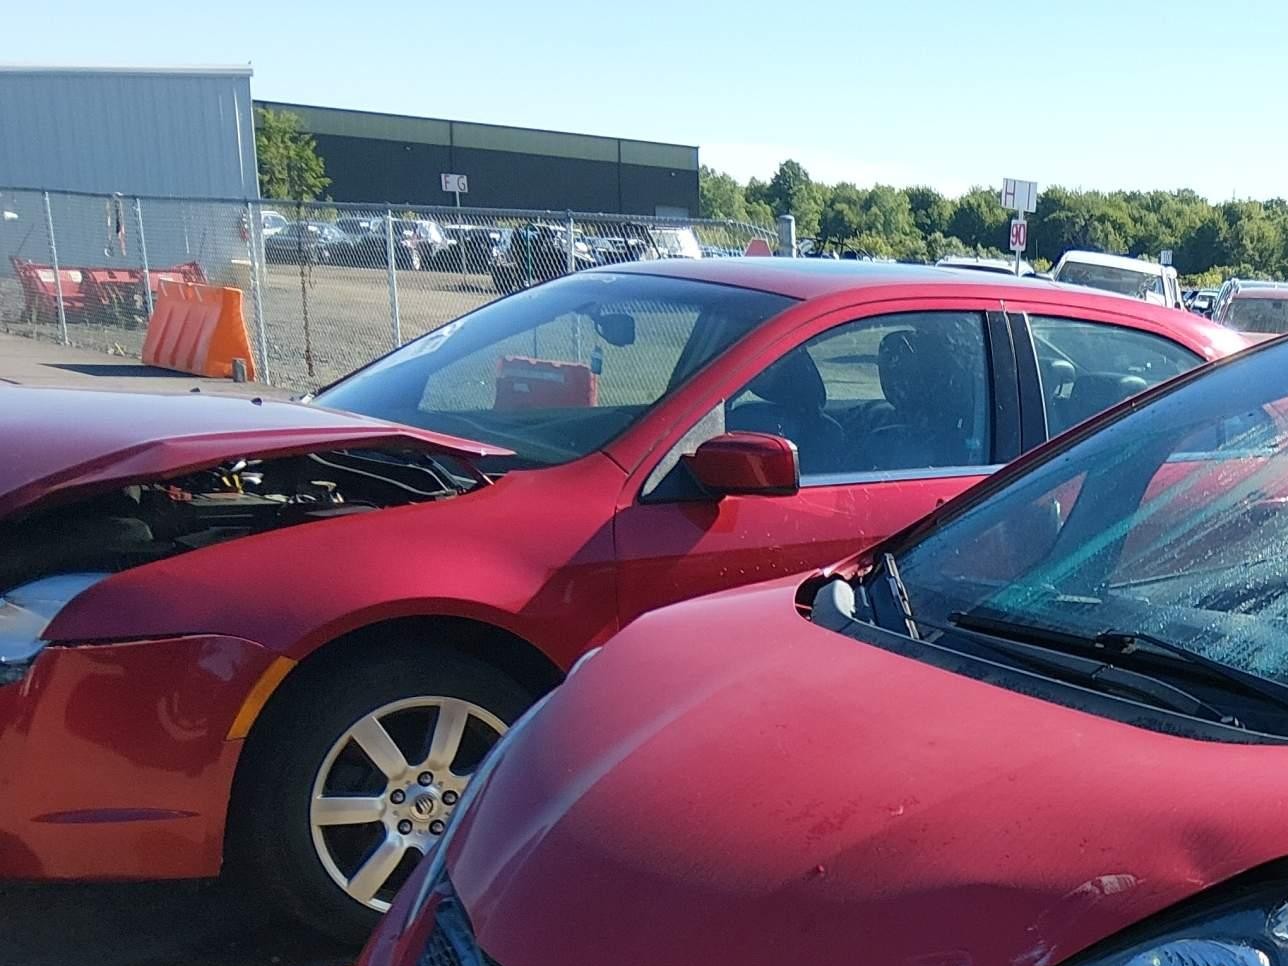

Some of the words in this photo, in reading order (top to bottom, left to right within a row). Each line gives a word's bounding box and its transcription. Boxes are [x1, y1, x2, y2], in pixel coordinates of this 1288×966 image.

[443, 175, 450, 190] F
[457, 175, 466, 191] G
[1004, 179, 1016, 208] H
[1011, 223, 1026, 246] 90
